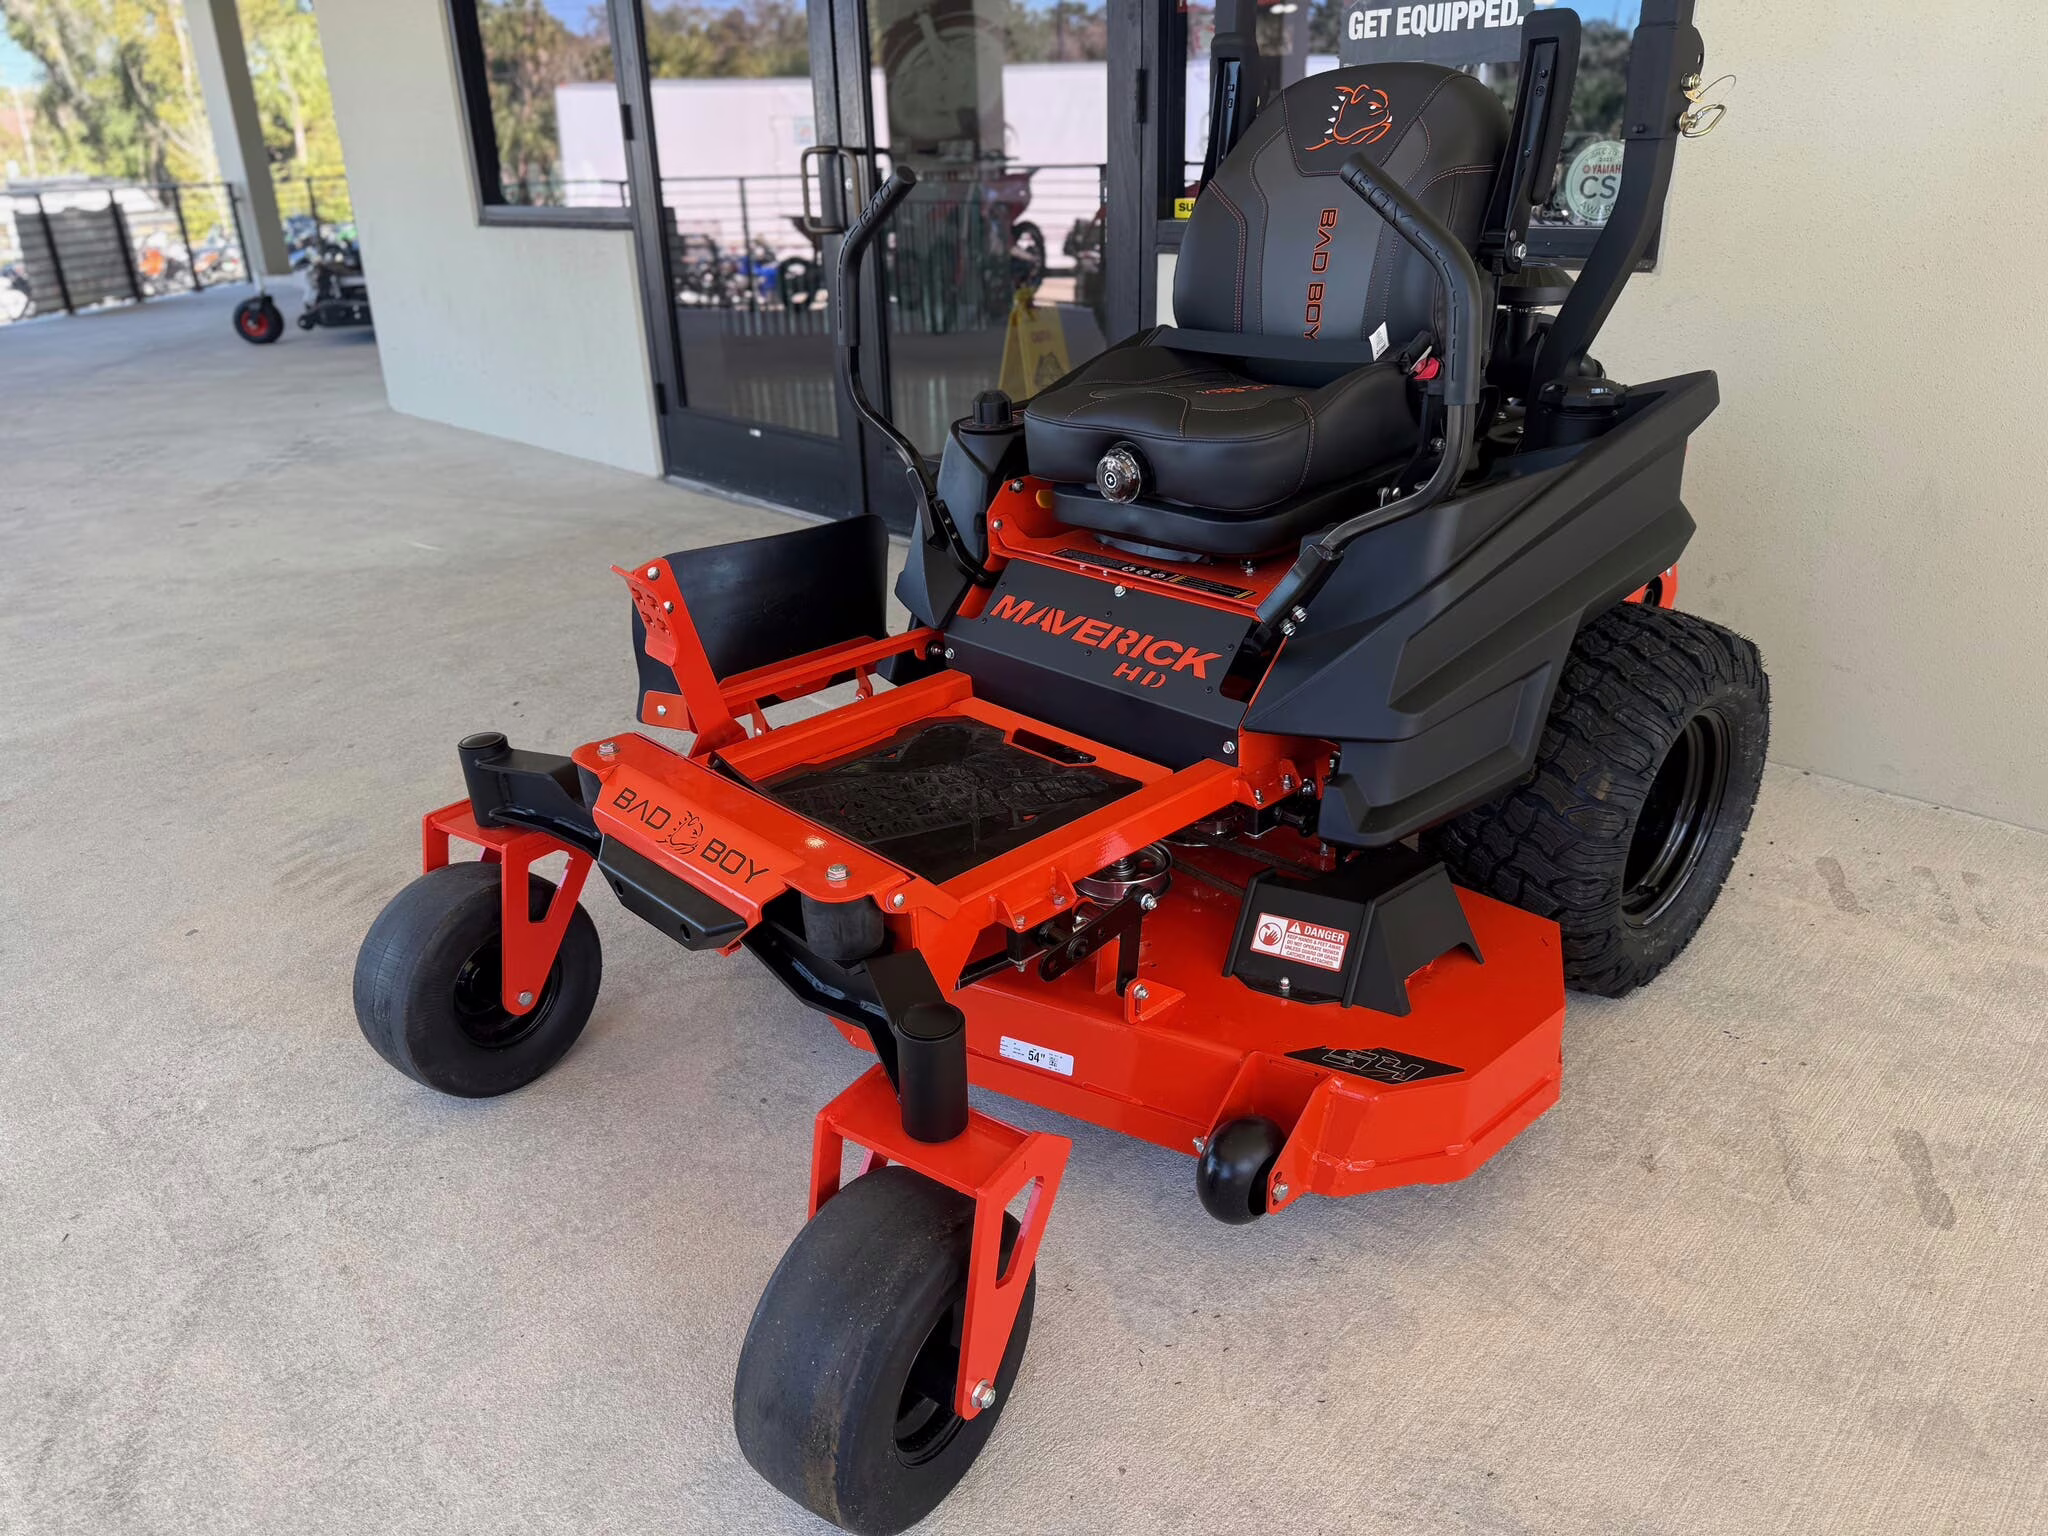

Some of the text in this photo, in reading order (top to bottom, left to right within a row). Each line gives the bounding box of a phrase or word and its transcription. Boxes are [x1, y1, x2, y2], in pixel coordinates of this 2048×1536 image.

[1348, 0, 1524, 40] GET EQUIPPED.
[1592, 164, 1622, 174] YAMAH
[1580, 201, 1614, 214] AWAR
[1304, 207, 1339, 340] BAD BOY
[990, 594, 1222, 680] MAVERICK
[1112, 662, 1167, 688] HD
[612, 787, 769, 884] BAD BOY
[1304, 926, 1345, 943] DANGER
[1027, 1050, 1046, 1063] 54"
